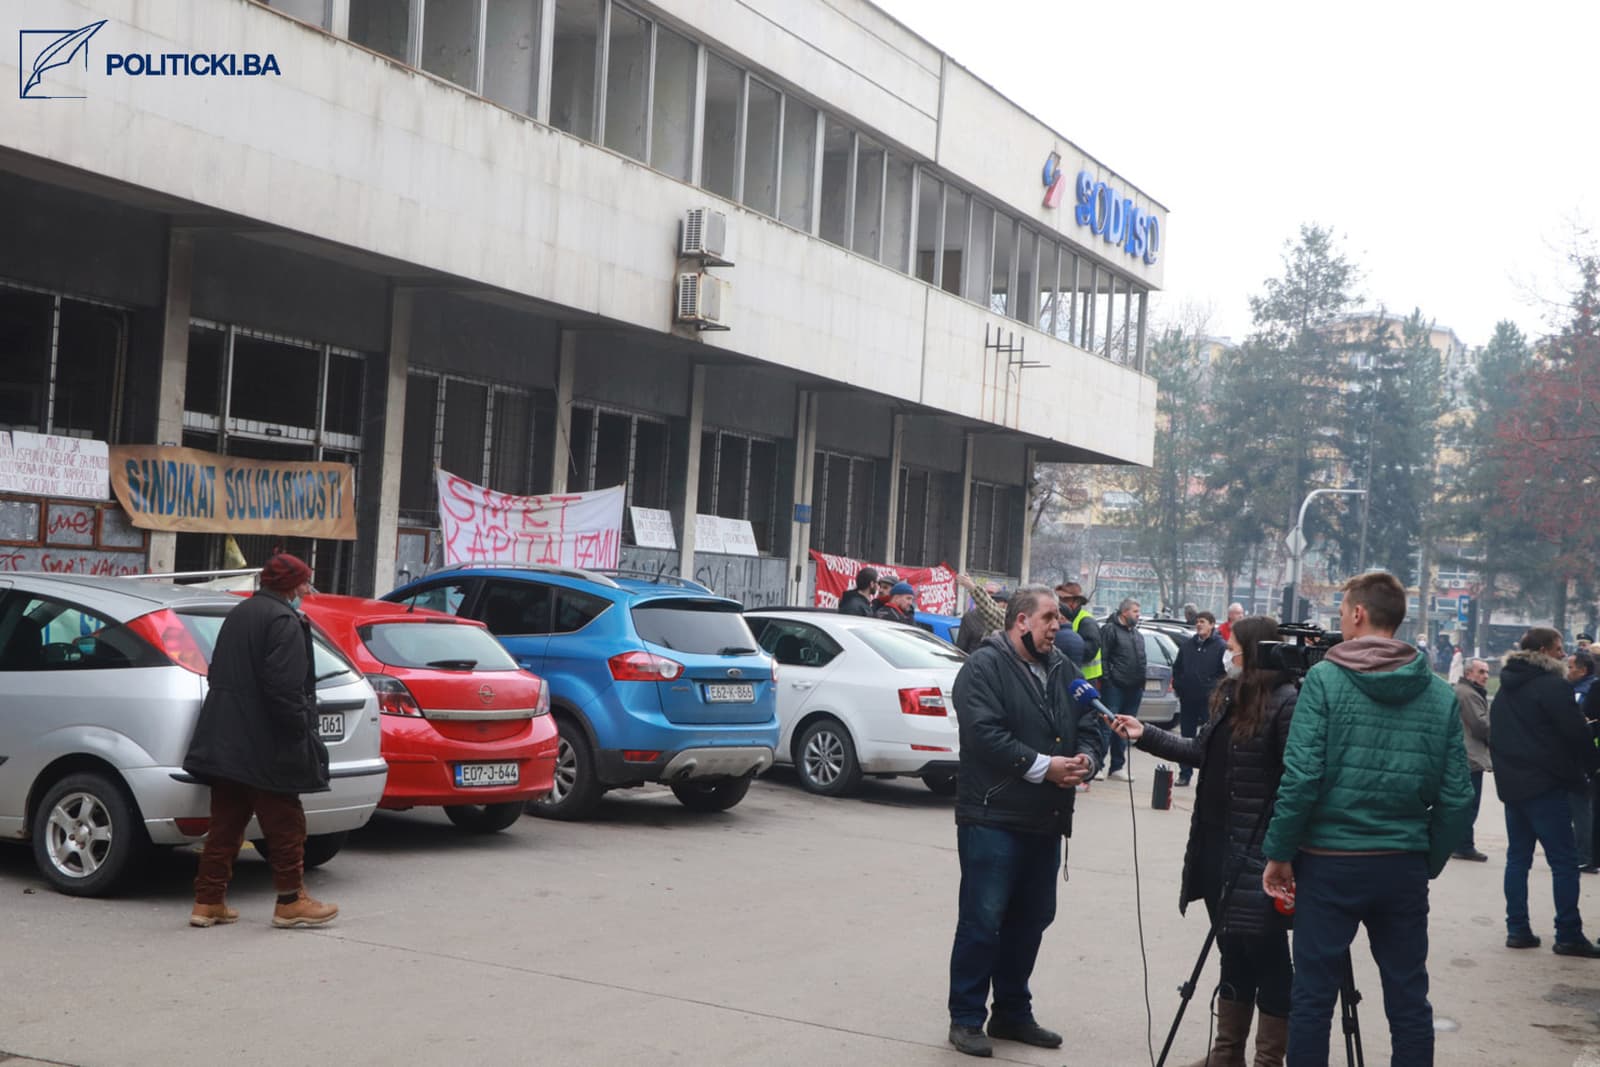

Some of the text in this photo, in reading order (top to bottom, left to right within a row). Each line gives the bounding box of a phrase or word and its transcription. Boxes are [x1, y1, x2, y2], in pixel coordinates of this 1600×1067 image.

[124, 458, 343, 521] SINDIKAT SOLIDARNOSTI
[443, 476, 582, 533] SMRT
[463, 764, 517, 781] E07-J-644
